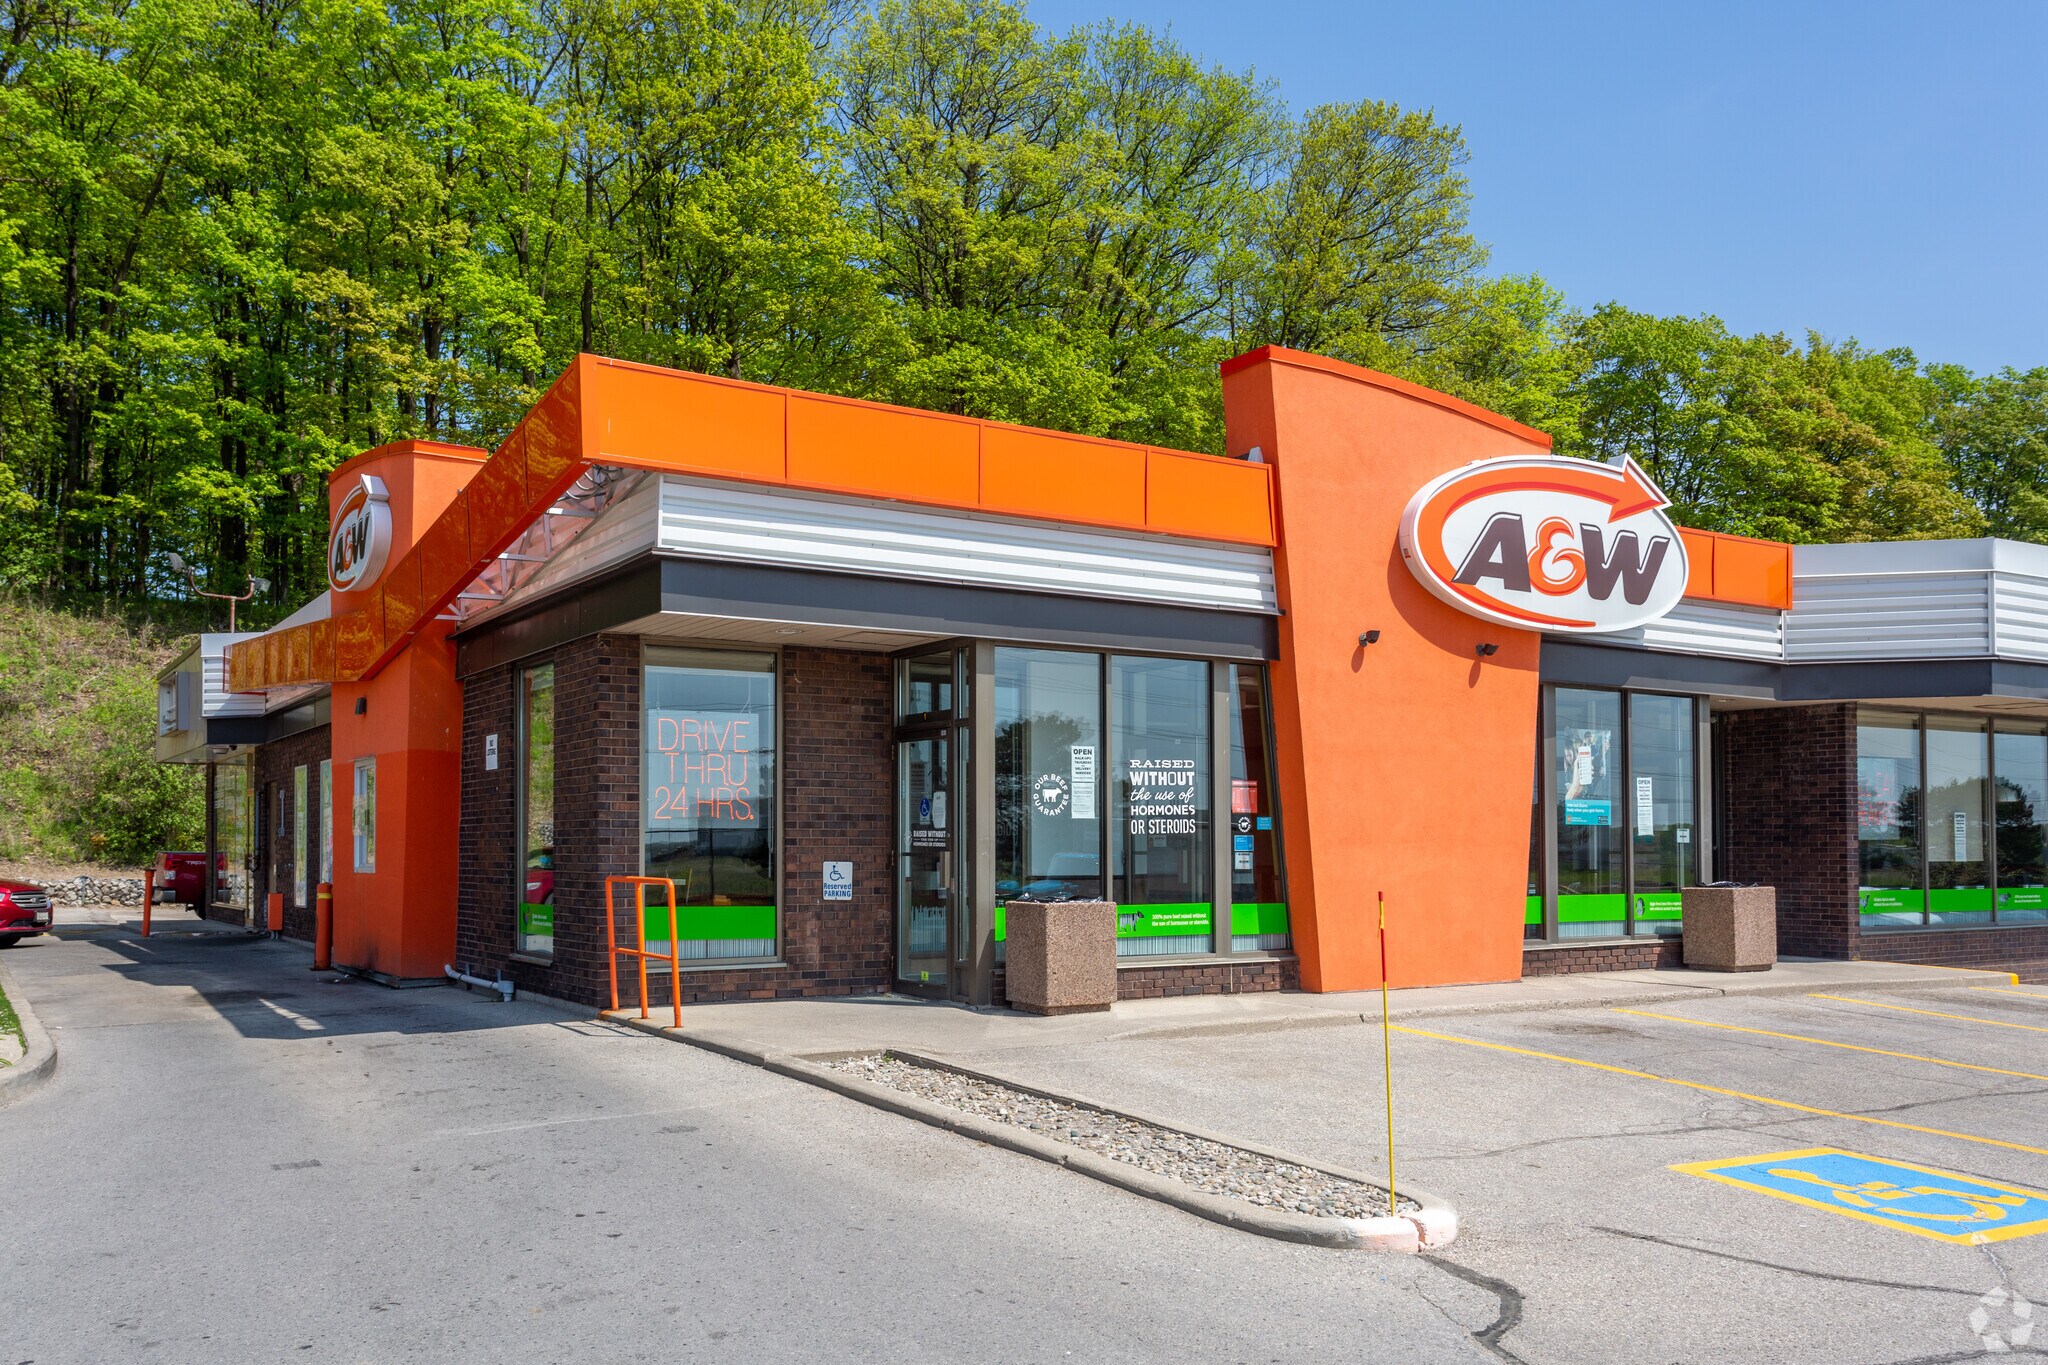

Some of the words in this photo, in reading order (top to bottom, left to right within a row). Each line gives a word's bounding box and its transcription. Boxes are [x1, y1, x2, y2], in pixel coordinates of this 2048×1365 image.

[334, 512, 371, 578] A&W
[1451, 511, 1671, 606] A&W
[658, 718, 750, 753] DRIVE
[1073, 748, 1093, 756] OPEN
[664, 752, 747, 786] THRU
[1129, 759, 1195, 769] RAISED
[1034, 774, 1049, 790] OUR
[1050, 773, 1068, 791] BEEF
[1129, 771, 1195, 786] WITHOUT
[654, 786, 689, 819] 24
[696, 787, 754, 820] HRS.
[1130, 787, 1152, 801] the
[1154, 790, 1176, 801] use
[1178, 786, 1195, 804] of
[1033, 793, 1069, 816] GUARANTEE
[1130, 804, 1196, 816] HORMONES
[928, 830, 946, 838] WITHOUT
[1130, 819, 1146, 835] OR
[1148, 819, 1196, 835] STEROIDS
[823, 882, 852, 890] Reserved
[823, 890, 851, 898] PARKING
